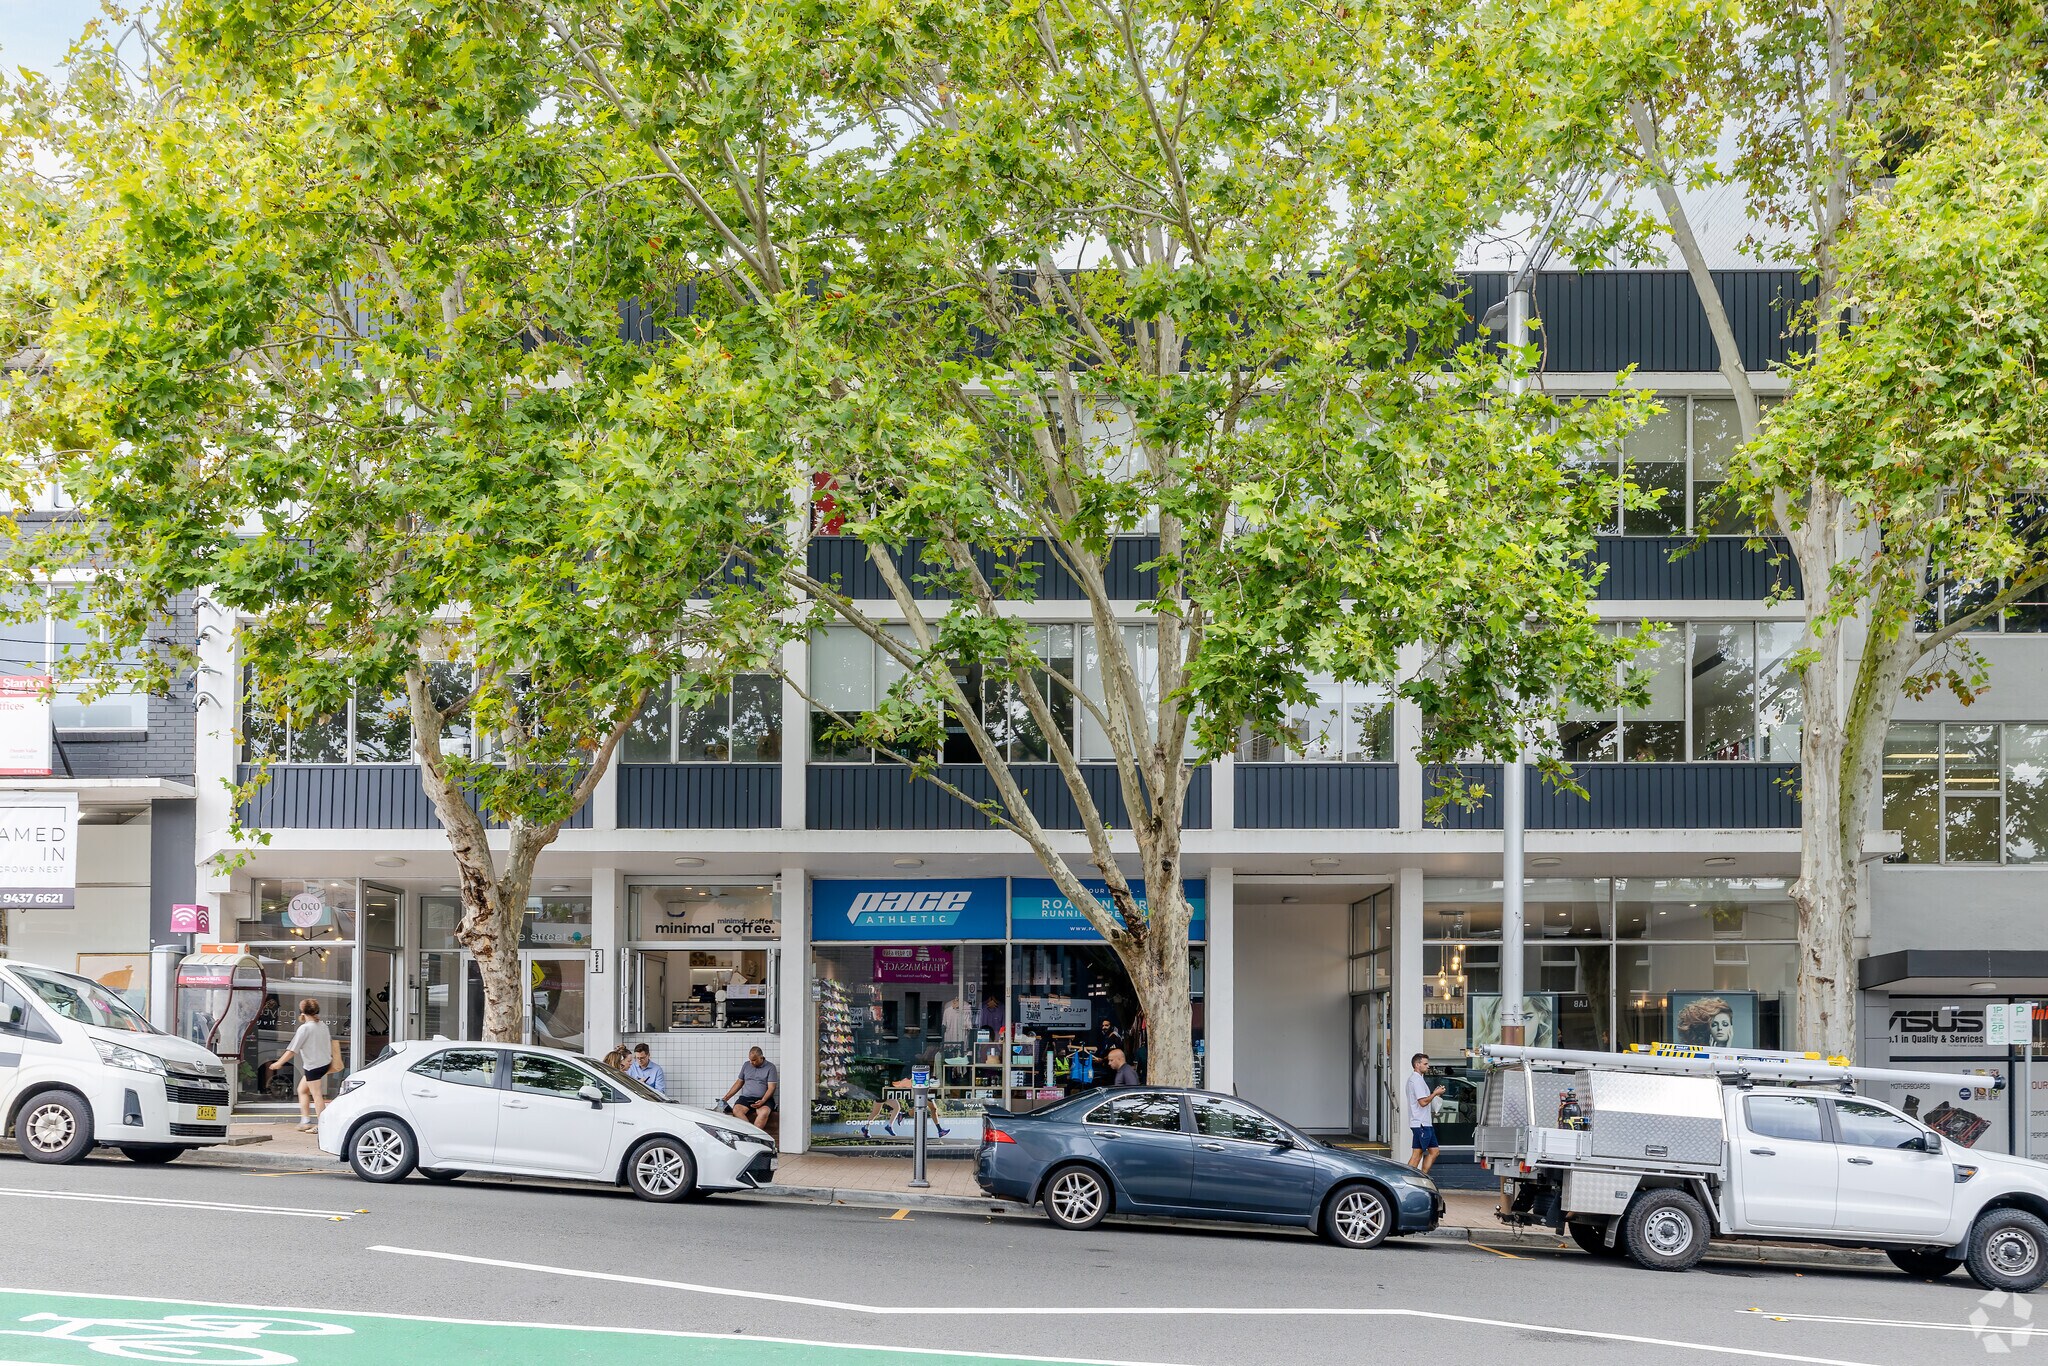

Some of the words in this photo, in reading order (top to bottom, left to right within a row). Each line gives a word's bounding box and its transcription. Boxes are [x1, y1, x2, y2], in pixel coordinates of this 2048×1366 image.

[43, 847, 65, 861] IN
[0, 865, 35, 873] CROWS
[39, 865, 64, 873] NEST
[3, 893, 34, 904] 9437
[35, 893, 64, 904] 6621
[847, 891, 973, 925] pace
[1041, 899, 1074, 909] ROA
[866, 915, 946, 924] ATHLETIC
[655, 922, 715, 934] minimal
[724, 922, 776, 934] coffee.
[2016, 1006, 2024, 1016] P
[1889, 1010, 1984, 1032] ASUS
[1992, 1024, 2005, 1032] 2P
[1901, 1035, 1909, 1043] in
[1911, 1034, 1939, 1044] Quality
[1940, 1034, 1947, 1043] &
[1949, 1034, 1984, 1043] Services
